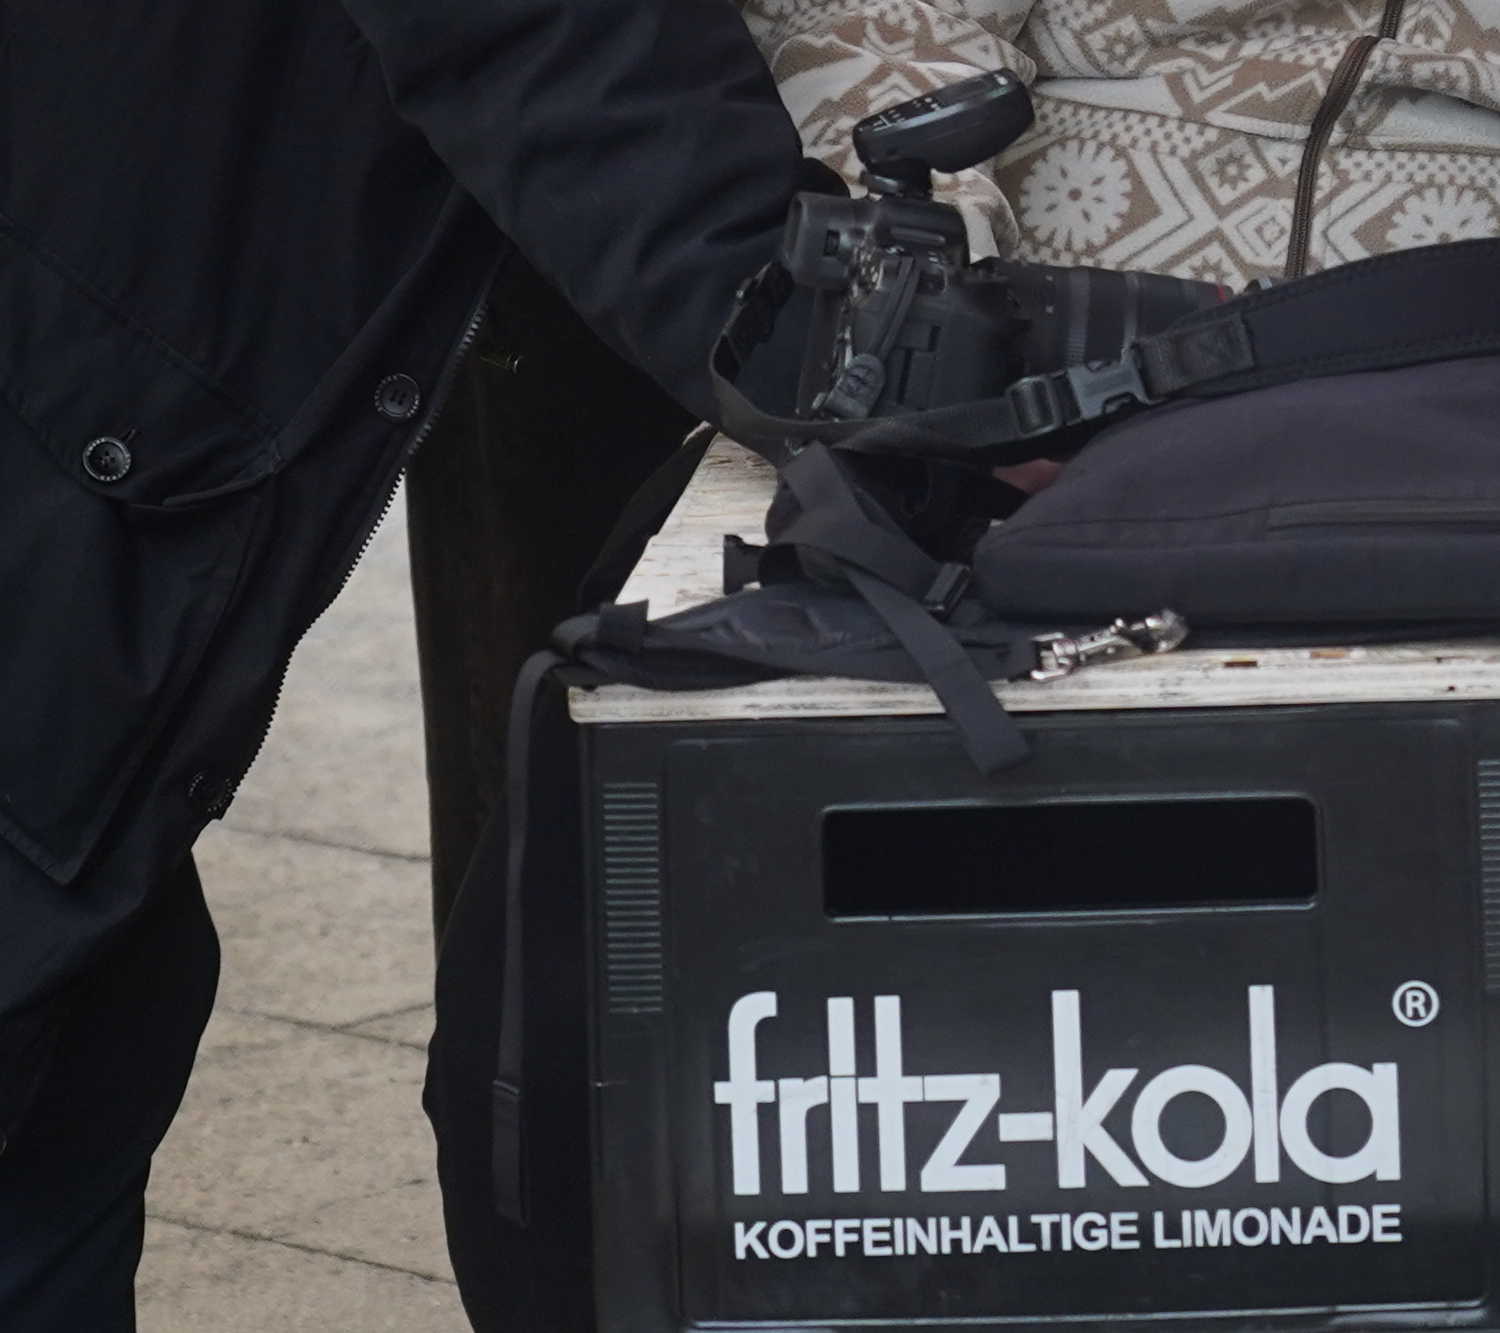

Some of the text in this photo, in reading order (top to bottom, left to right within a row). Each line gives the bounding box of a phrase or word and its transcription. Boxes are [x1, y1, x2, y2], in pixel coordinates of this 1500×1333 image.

[714, 984, 1400, 1195] fritz-kola
[734, 1203, 1402, 1260] KOFFEINHALTIGE LIMONADE
